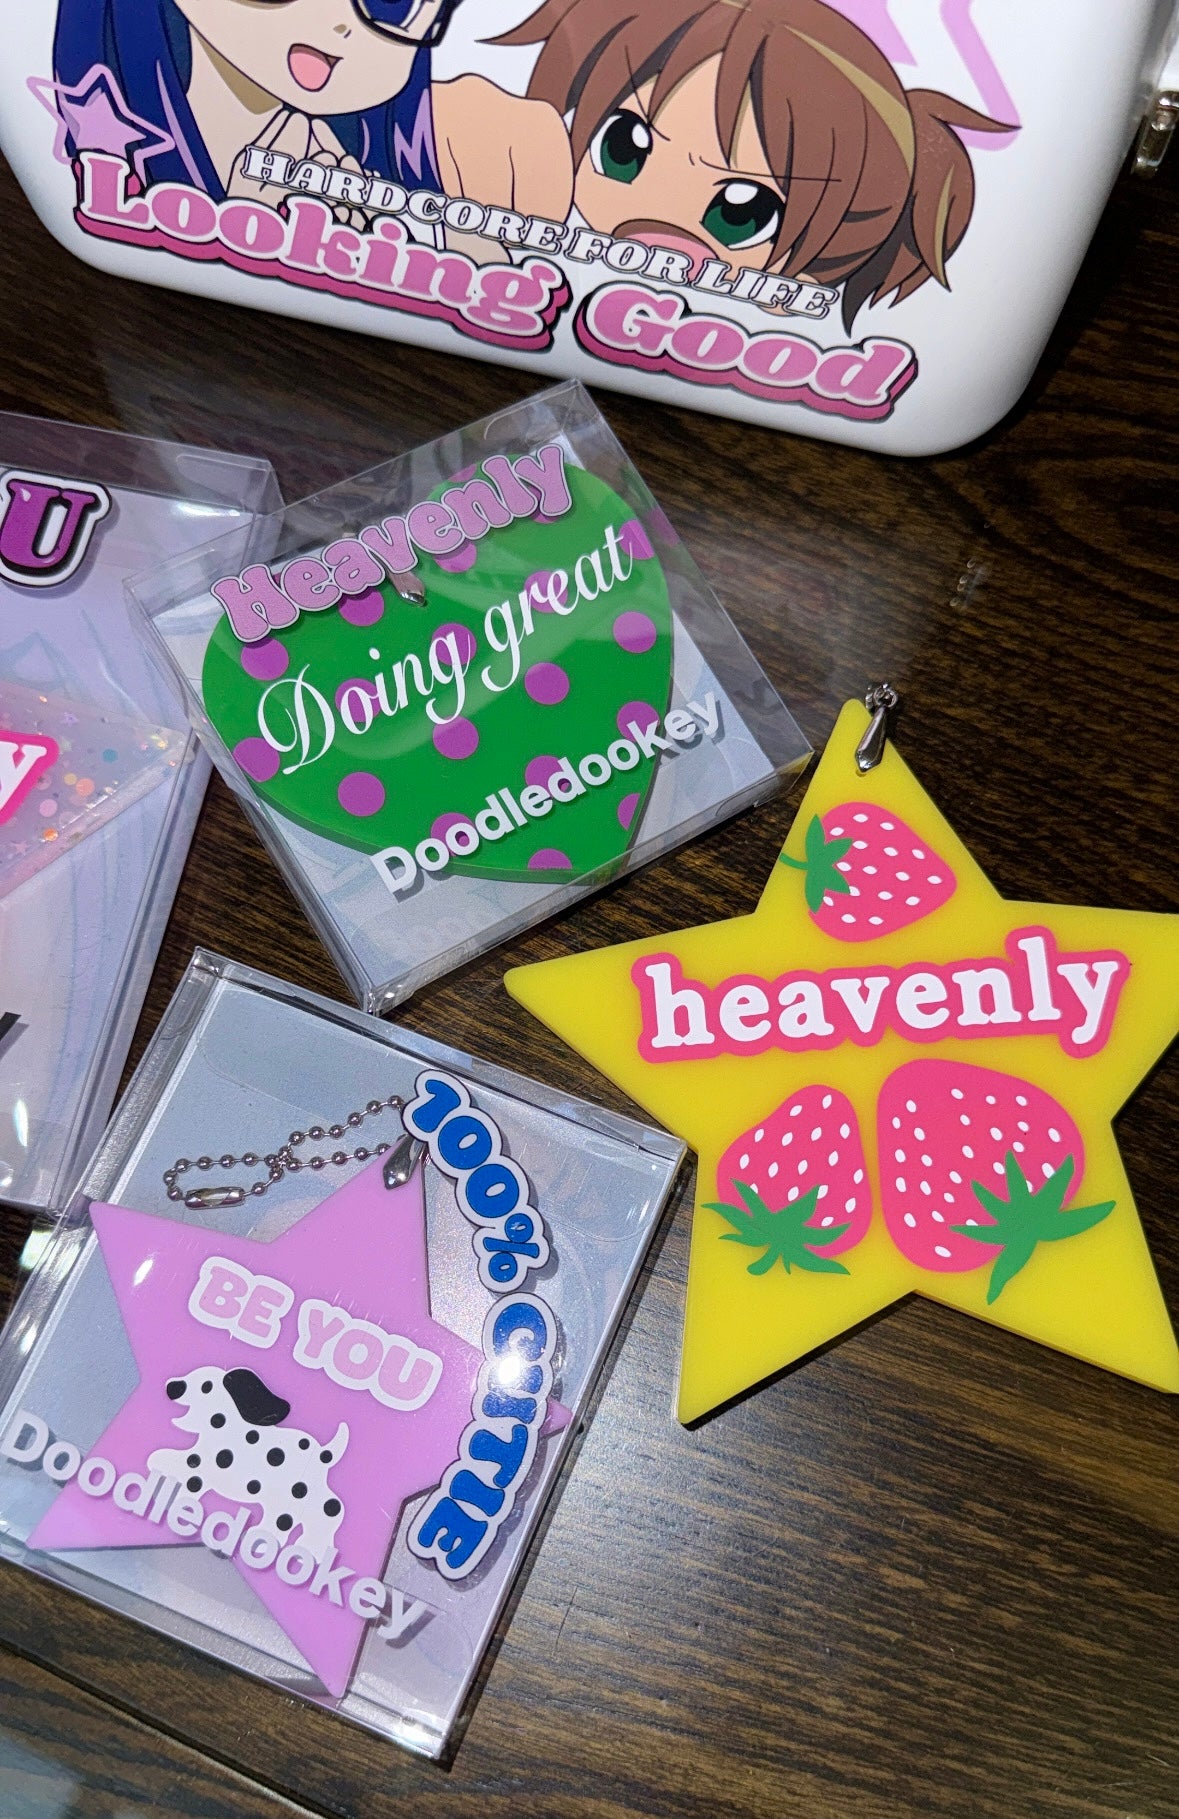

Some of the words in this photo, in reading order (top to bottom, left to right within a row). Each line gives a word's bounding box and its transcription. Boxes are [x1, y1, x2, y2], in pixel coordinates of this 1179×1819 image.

[80, 151, 566, 339] Looking
[584, 283, 911, 410] Good
[244, 147, 567, 252] HARDCORE
[567, 229, 692, 285] FOR
[692, 260, 838, 318] LIFE
[211, 443, 574, 643] Heavenly
[257, 631, 471, 775] Doing
[481, 525, 633, 692] great
[371, 690, 721, 893] Doodledookey
[643, 935, 1119, 1048] heavenly
[407, 1075, 544, 1287] 100%
[199, 1263, 289, 1341] BE
[298, 1303, 437, 1402] YOU
[4, 1414, 428, 1641] Doodledookey
